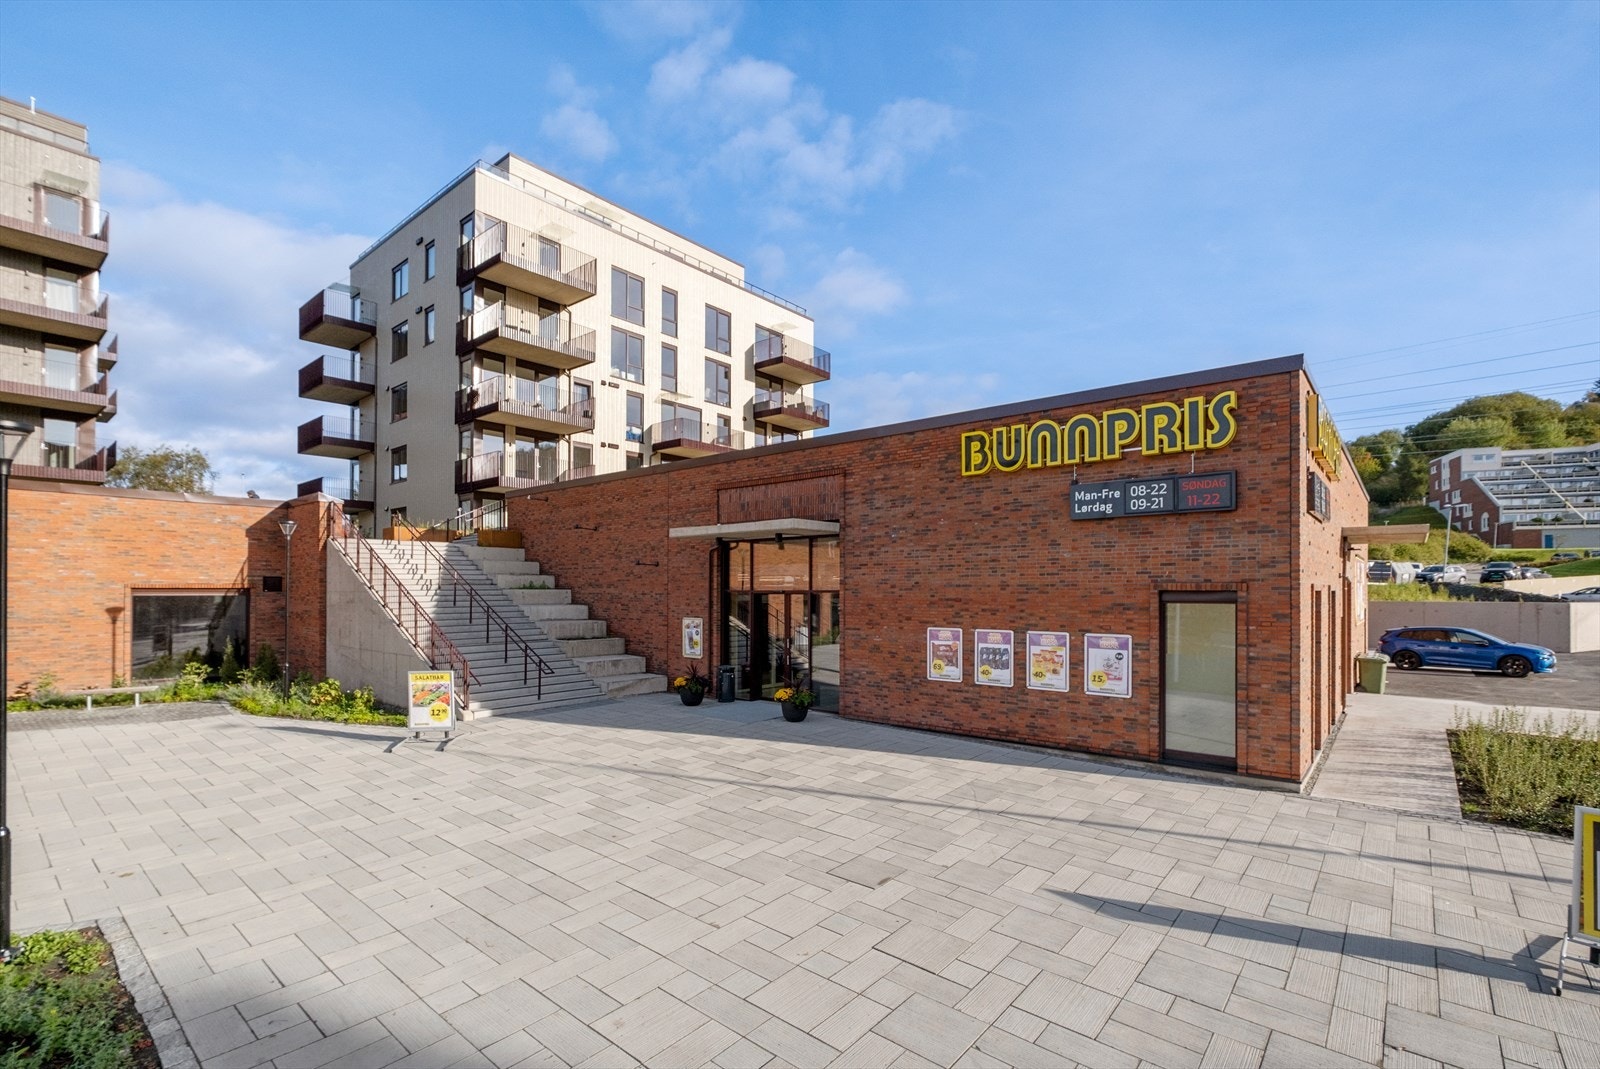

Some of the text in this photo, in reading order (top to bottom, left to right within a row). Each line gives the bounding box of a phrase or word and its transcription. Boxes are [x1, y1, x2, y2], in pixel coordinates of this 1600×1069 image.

[961, 390, 1238, 476] BUNNPRIS
[1075, 483, 1168, 501] Man-Fre 08-22
[1182, 478, 1226, 491] SØNDAG
[1075, 497, 1164, 514] Lørdag 09-21
[1186, 493, 1220, 506] 11-22
